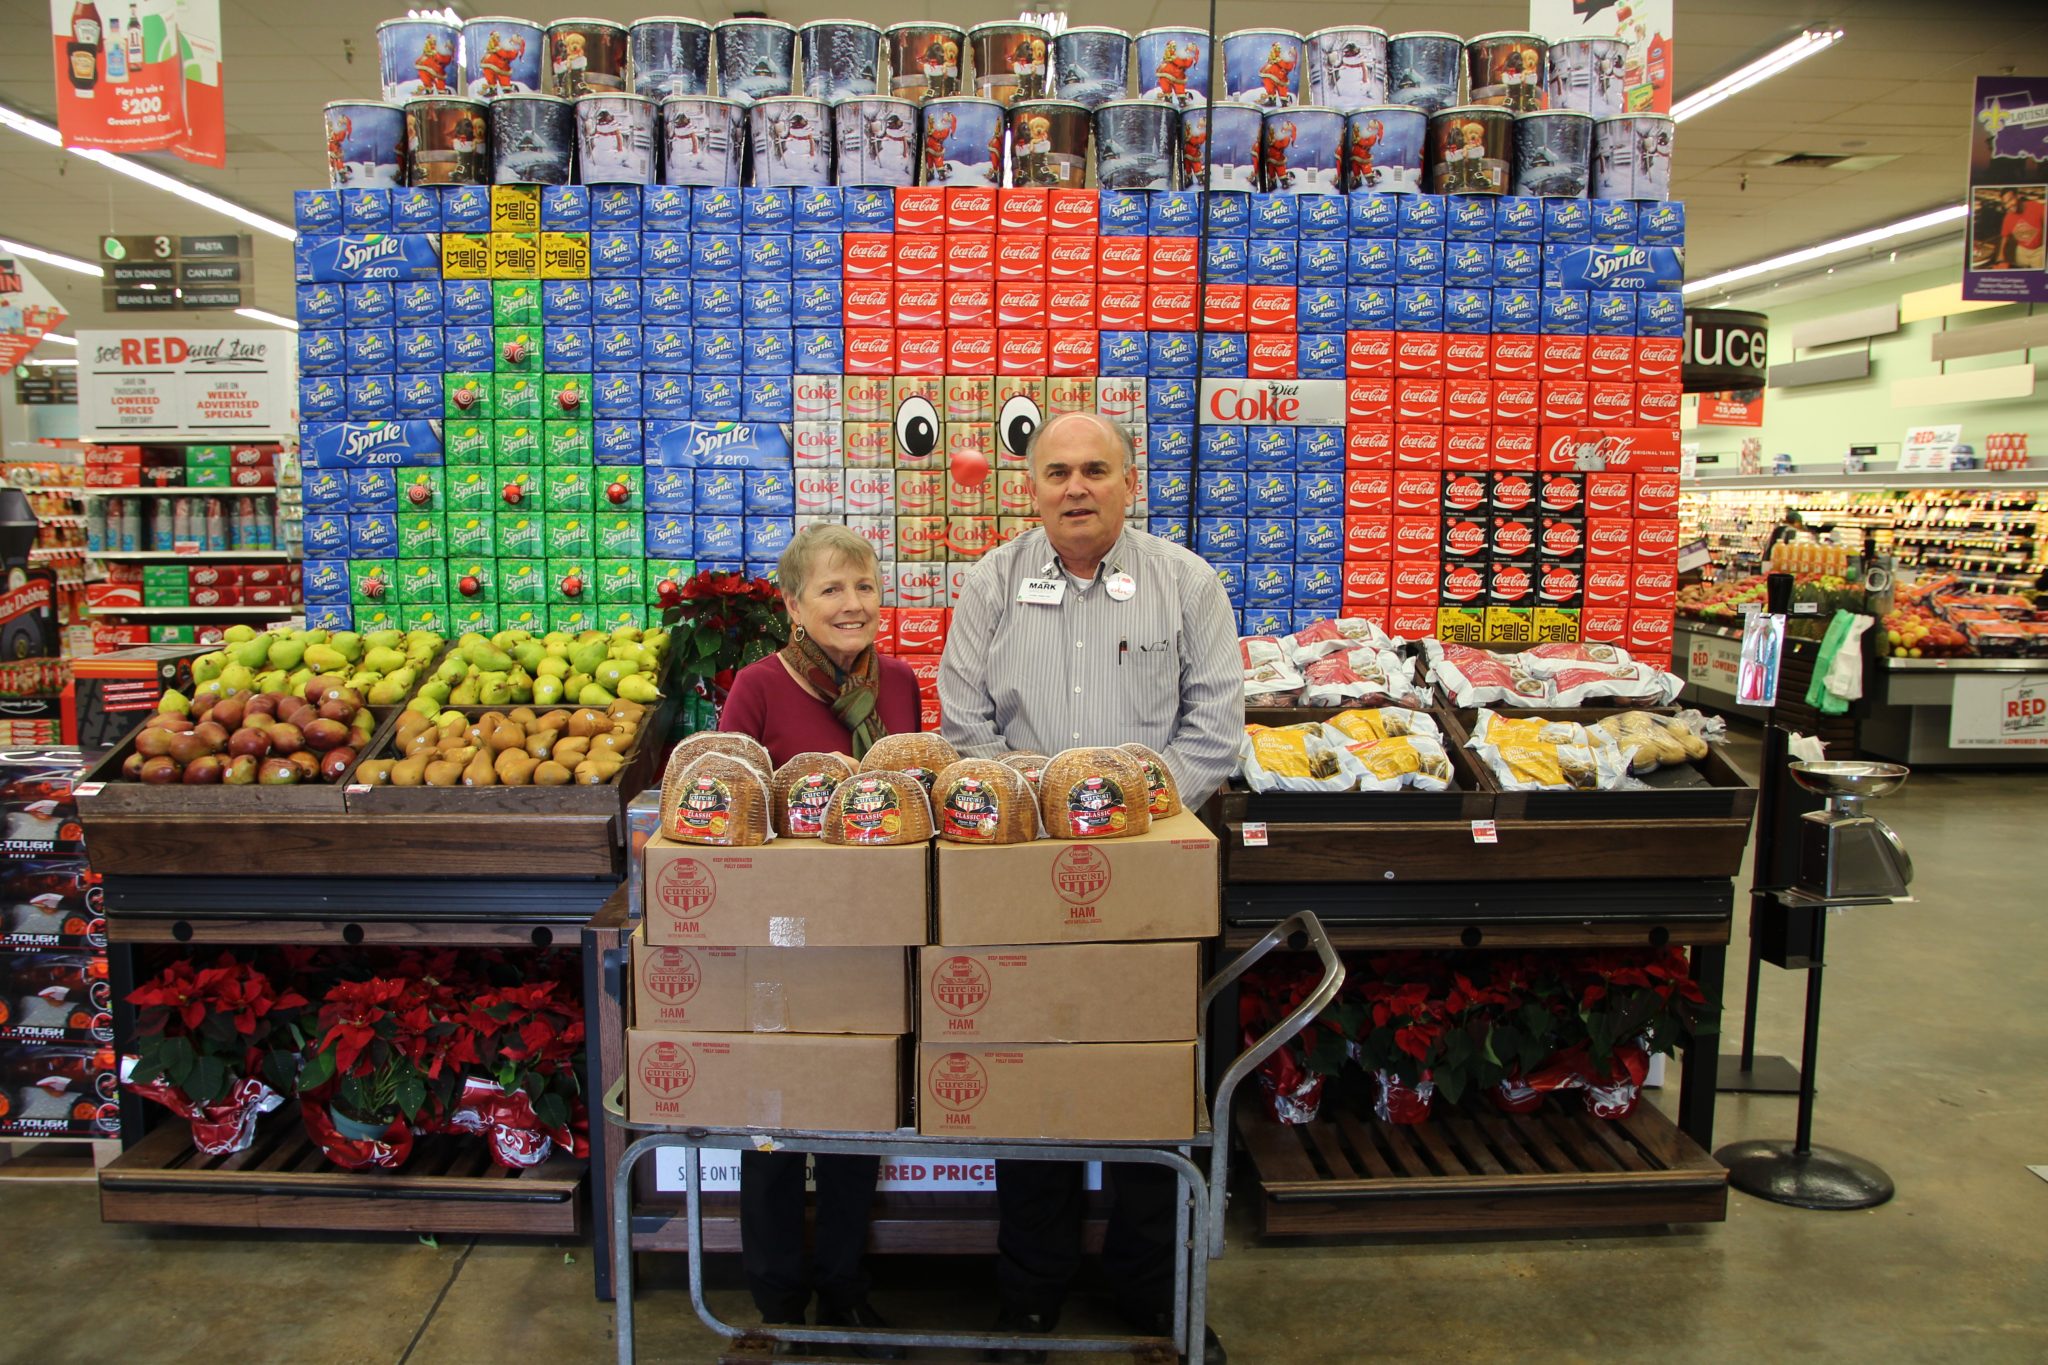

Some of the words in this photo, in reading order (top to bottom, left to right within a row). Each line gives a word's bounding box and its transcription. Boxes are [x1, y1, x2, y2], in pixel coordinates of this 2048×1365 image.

[116, 87, 133, 96] Play
[122, 96, 162, 115] $200
[107, 117, 141, 126] Grocery
[305, 199, 331, 217] Sprite
[603, 198, 628, 213] Sprite
[614, 208, 631, 216] zero
[900, 198, 941, 213] Coca-Cola
[1003, 198, 1043, 213] Coca-Cola
[1210, 204, 1239, 218] Sprite
[1409, 207, 1436, 222] Sprite
[155, 236, 171, 258] 3
[195, 242, 224, 251] PASTA
[343, 236, 399, 271] Sprite
[849, 244, 889, 259] Coca-Cola
[1153, 247, 1192, 262] Coca-Cola
[1591, 247, 1646, 279] Sprite
[115, 270, 133, 278] BOX
[134, 269, 172, 278] DINNERS
[187, 269, 206, 278] CAN
[208, 269, 233, 277] FRUIT
[363, 266, 399, 279] zero
[1611, 277, 1646, 289] zero
[117, 295, 144, 304] BEANS
[153, 295, 172, 304] RICE
[199, 294, 239, 303] VEGETABLES
[502, 295, 534, 312] Sprite
[1252, 296, 1291, 311] Coca-Cola
[121, 337, 188, 366] RED
[187, 338, 224, 358] and
[807, 339, 833, 354] Sprite
[1053, 339, 1093, 354] Coca-Cola
[1448, 345, 1484, 359] Coca-Cola
[207, 391, 247, 400] WEEKLY
[797, 384, 837, 400] Coke
[848, 385, 888, 401] Coke
[1268, 382, 1299, 397] Diet
[111, 397, 160, 405] LOWERED
[197, 401, 259, 409] ADVERTISED
[1210, 387, 1299, 422] Coke
[1641, 392, 1678, 407] Coca-Cola
[118, 406, 154, 414] PRICES
[204, 410, 253, 419] SPECIALS
[120, 416, 139, 424] EVERY
[346, 423, 401, 455] Sprite
[454, 435, 485, 452] Sprite
[692, 423, 750, 455] Sprite
[1914, 431, 1934, 444] RED
[1258, 438, 1285, 454] Sprite
[367, 452, 401, 464] zero
[713, 454, 749, 466] zero
[657, 479, 684, 495] Sprite
[799, 478, 839, 494] Coke
[1350, 481, 1388, 494] Coca-Cola
[1495, 527, 1534, 543] Coca-Cola
[505, 573, 536, 589] Sprite
[900, 573, 940, 588] Coke
[1029, 582, 1056, 590] MARK
[900, 617, 940, 633] Coca-Cola
[1632, 619, 1670, 633] Coca-Cola
[1693, 652, 1708, 666] RED
[2008, 698, 2046, 718] RED
[1084, 810, 1111, 818] CLASSIC
[1070, 907, 1095, 918] HAM
[674, 922, 699, 932] HAM
[661, 1008, 684, 1018] HAM
[949, 1019, 974, 1029] HAM
[656, 1102, 679, 1112] HAM
[946, 1114, 970, 1124] HAM
[710, 1166, 727, 1181] ON
